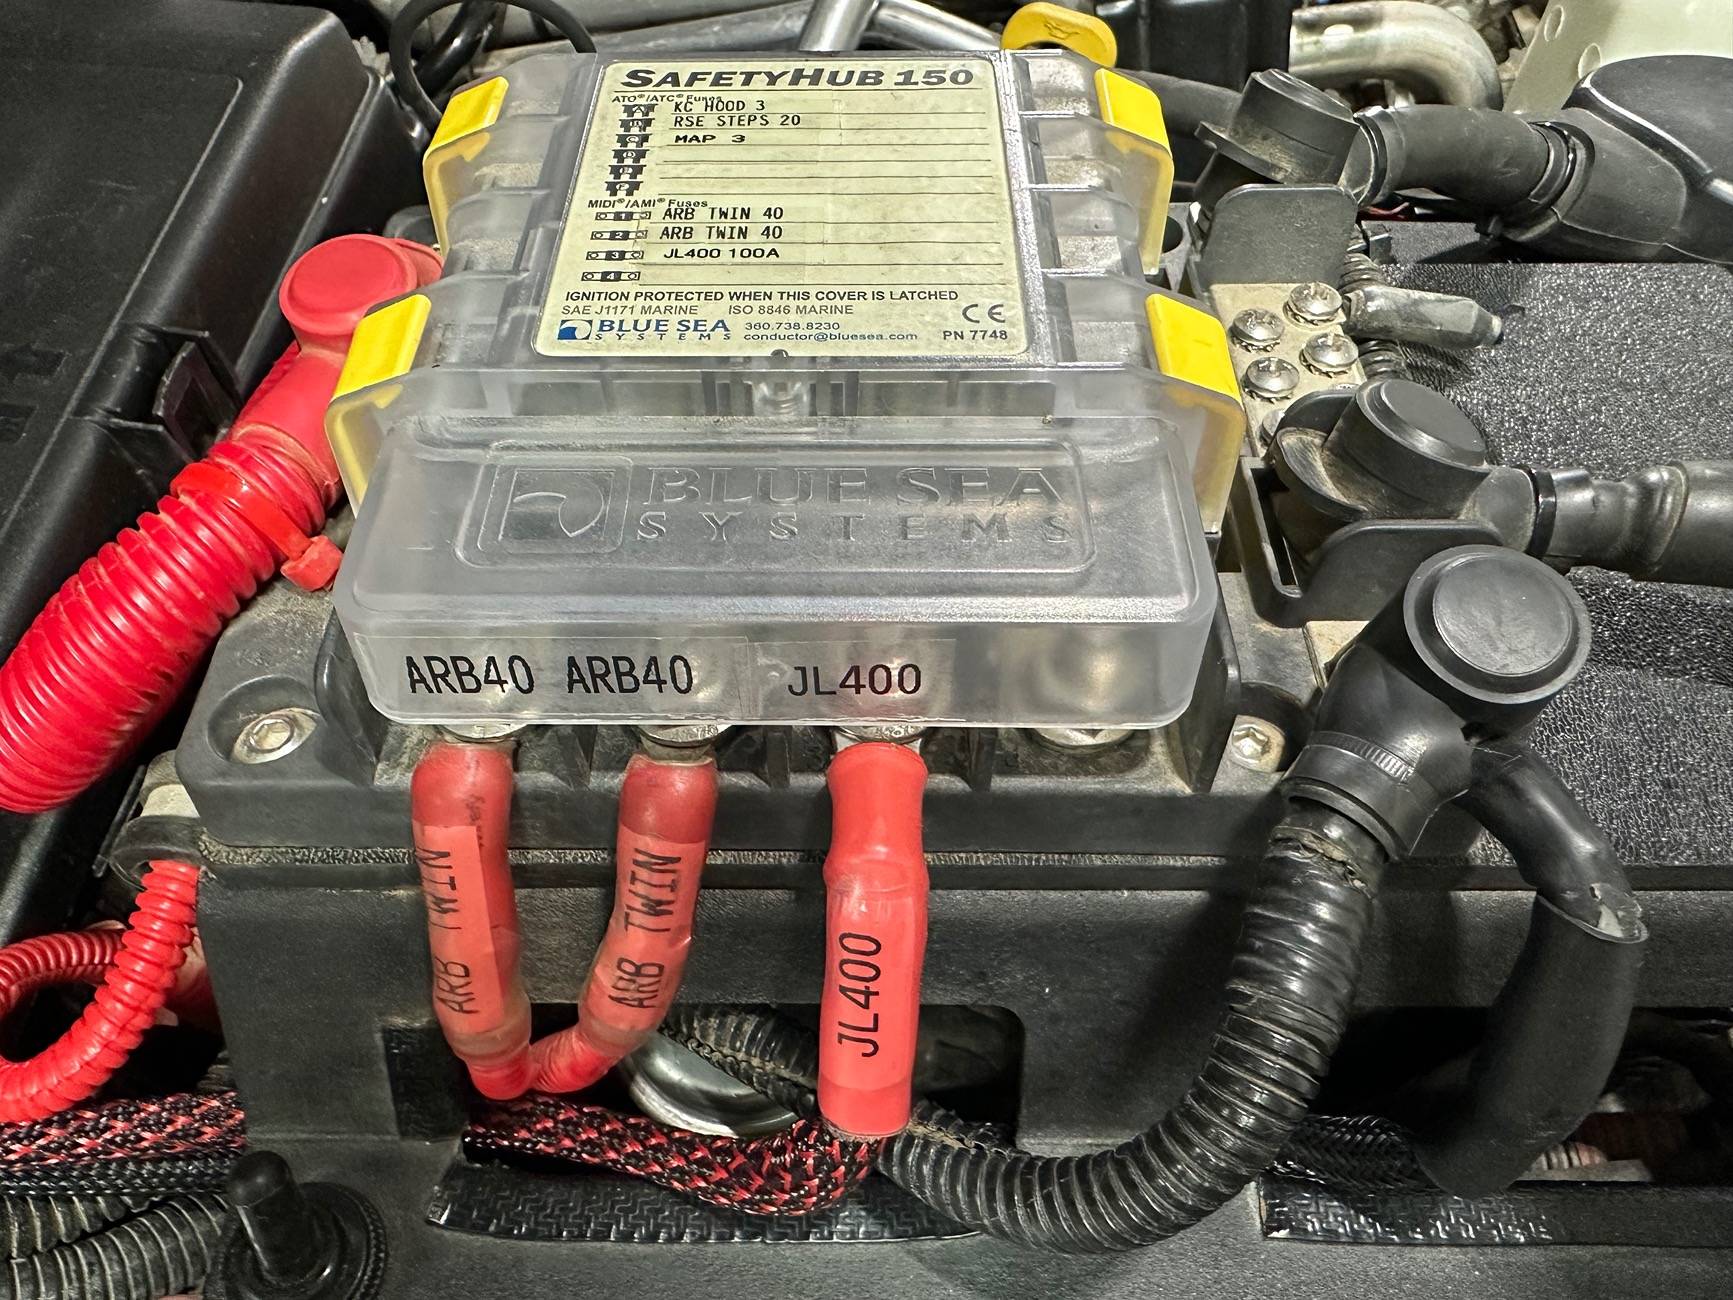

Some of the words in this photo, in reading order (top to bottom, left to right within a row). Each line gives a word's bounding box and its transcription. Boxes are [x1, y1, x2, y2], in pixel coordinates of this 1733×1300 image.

[893, 69, 974, 86] 150
[673, 101, 694, 113] KC
[704, 100, 746, 113] HOOD
[755, 100, 766, 111] 3
[673, 115, 705, 128] RSE
[716, 115, 770, 127] STEPS
[779, 114, 801, 126] 20
[674, 134, 716, 144] MAP
[731, 134, 746, 144] 3
[668, 199, 708, 208] Fuses
[662, 207, 695, 220] ARB
[709, 207, 751, 220] TWIN
[763, 207, 784, 220] 40
[659, 226, 694, 240] ARB
[705, 226, 748, 239] TWIN
[760, 226, 783, 239] 40
[663, 248, 721, 259] JL400
[729, 248, 780, 258] 100A
[565, 291, 631, 302] IGNITION
[633, 291, 725, 302] PROTECTED
[728, 291, 773, 301] WHEN
[777, 291, 811, 301] THIS
[814, 291, 867, 301] COVER
[871, 291, 886, 300] IS
[890, 290, 959, 301] LATCHED
[561, 305, 591, 315] SAE
[595, 305, 635, 315] J1171
[640, 305, 699, 315] MARINE
[728, 305, 754, 315] ISO
[757, 305, 791, 315] 8846
[795, 304, 854, 315] MARINE
[597, 319, 670, 333] BLUE
[676, 319, 731, 333] SEA
[744, 321, 841, 331] 360.738.8230
[594, 333, 731, 341] SYSTEMS
[743, 331, 918, 343] conductor@bluesea.com
[942, 330, 965, 341] PN
[969, 330, 1009, 341] 7748
[643, 466, 870, 505] BLUE
[898, 465, 1063, 505] SEA
[636, 511, 1073, 543] SYSTEMS
[405, 655, 536, 695] ARB40
[566, 655, 694, 695] ARB40
[787, 663, 922, 697] JL400
[623, 848, 682, 933] TWIN
[434, 955, 480, 1014] ARB
[607, 956, 665, 1010] ARB
[837, 932, 882, 1058] JL400
